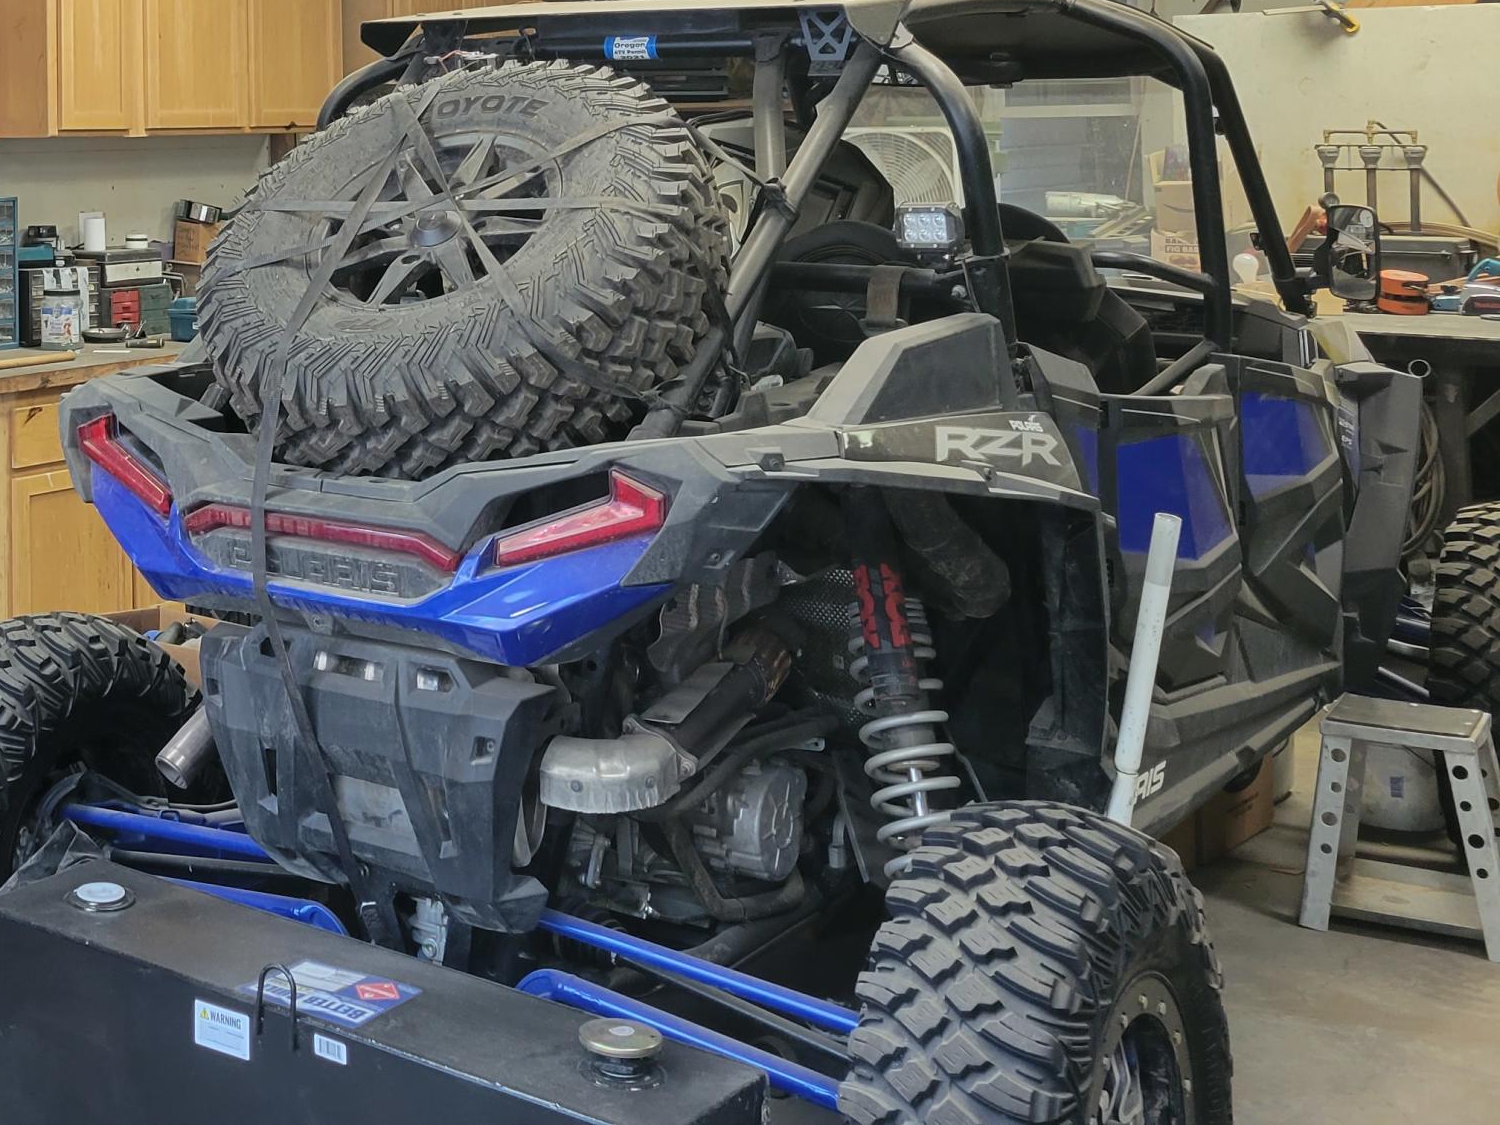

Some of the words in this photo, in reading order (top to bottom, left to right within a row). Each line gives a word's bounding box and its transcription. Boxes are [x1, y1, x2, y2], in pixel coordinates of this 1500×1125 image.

[935, 425, 1062, 467] RZR
[227, 540, 401, 597] PLARIS
[210, 1009, 242, 1030] WARNING
[303, 994, 365, 1020] BETTER
